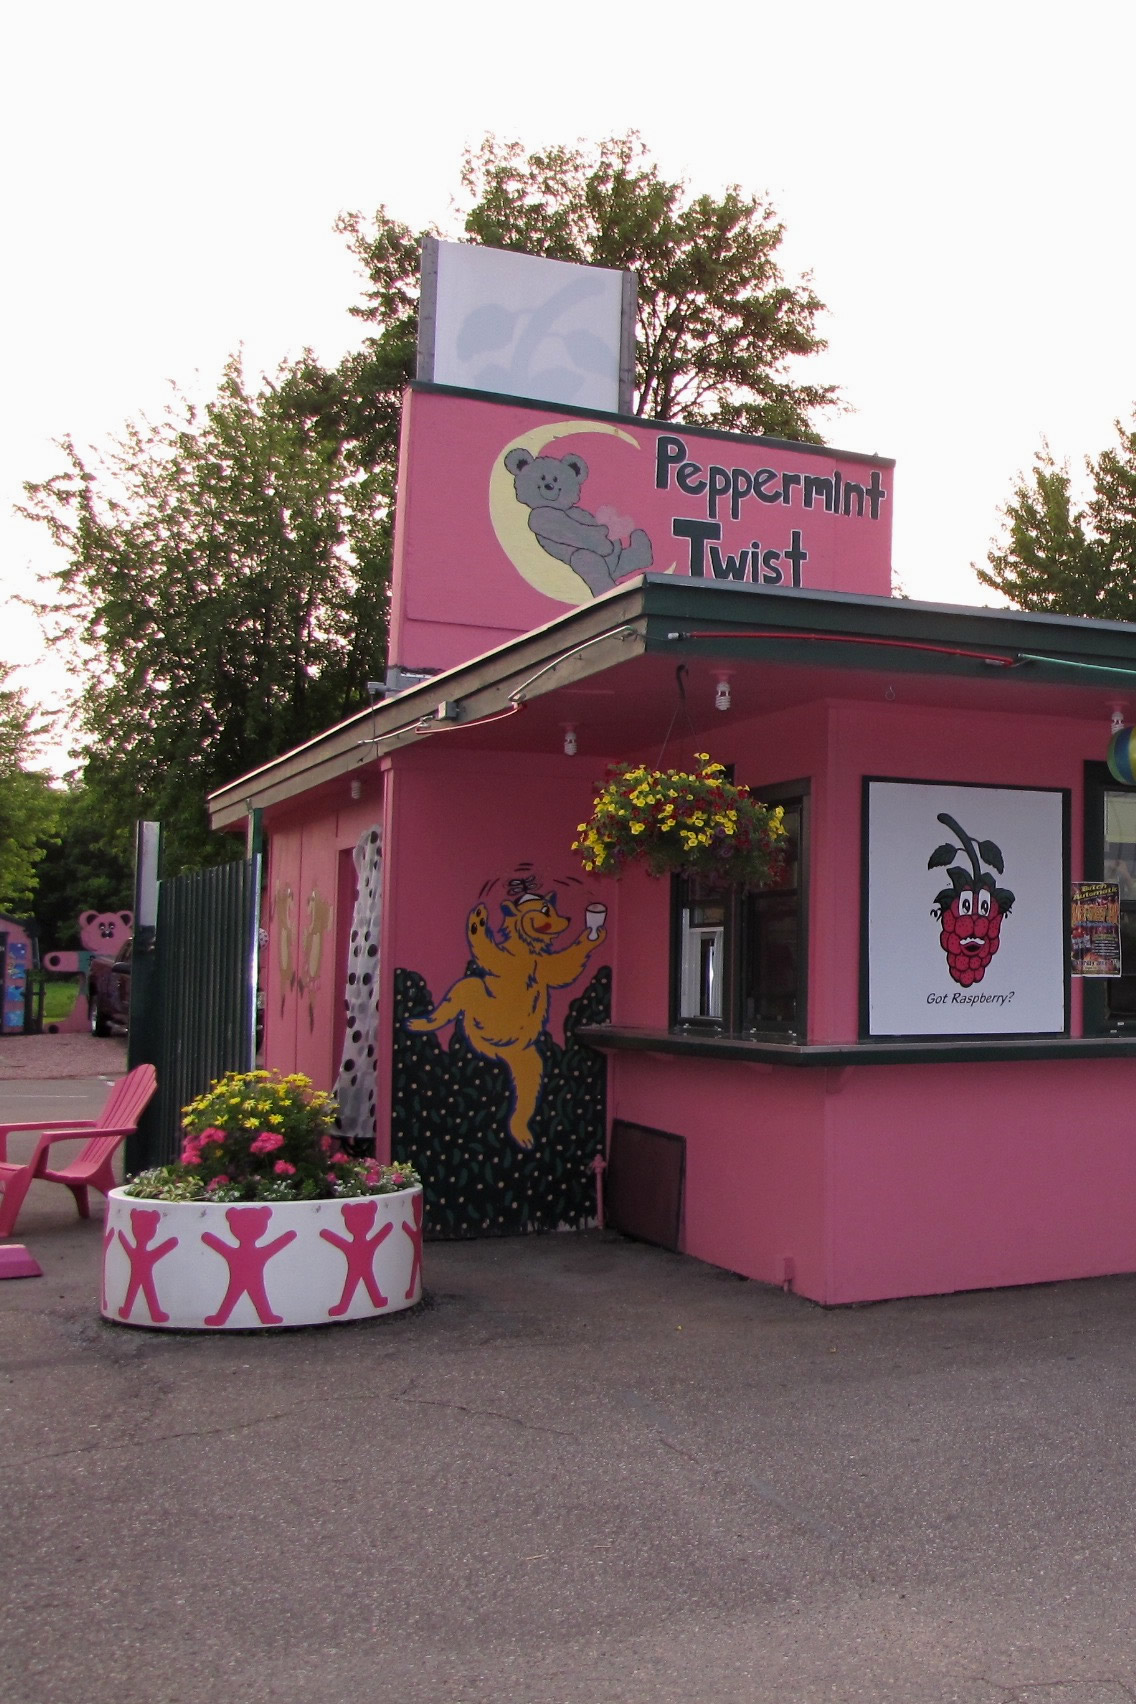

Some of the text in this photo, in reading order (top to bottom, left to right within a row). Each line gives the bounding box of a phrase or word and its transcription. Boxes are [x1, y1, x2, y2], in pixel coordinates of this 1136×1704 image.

[655, 435, 887, 521] Peppermint
[671, 517, 809, 588] Twist
[926, 991, 1015, 1007] Got Raspberry?
